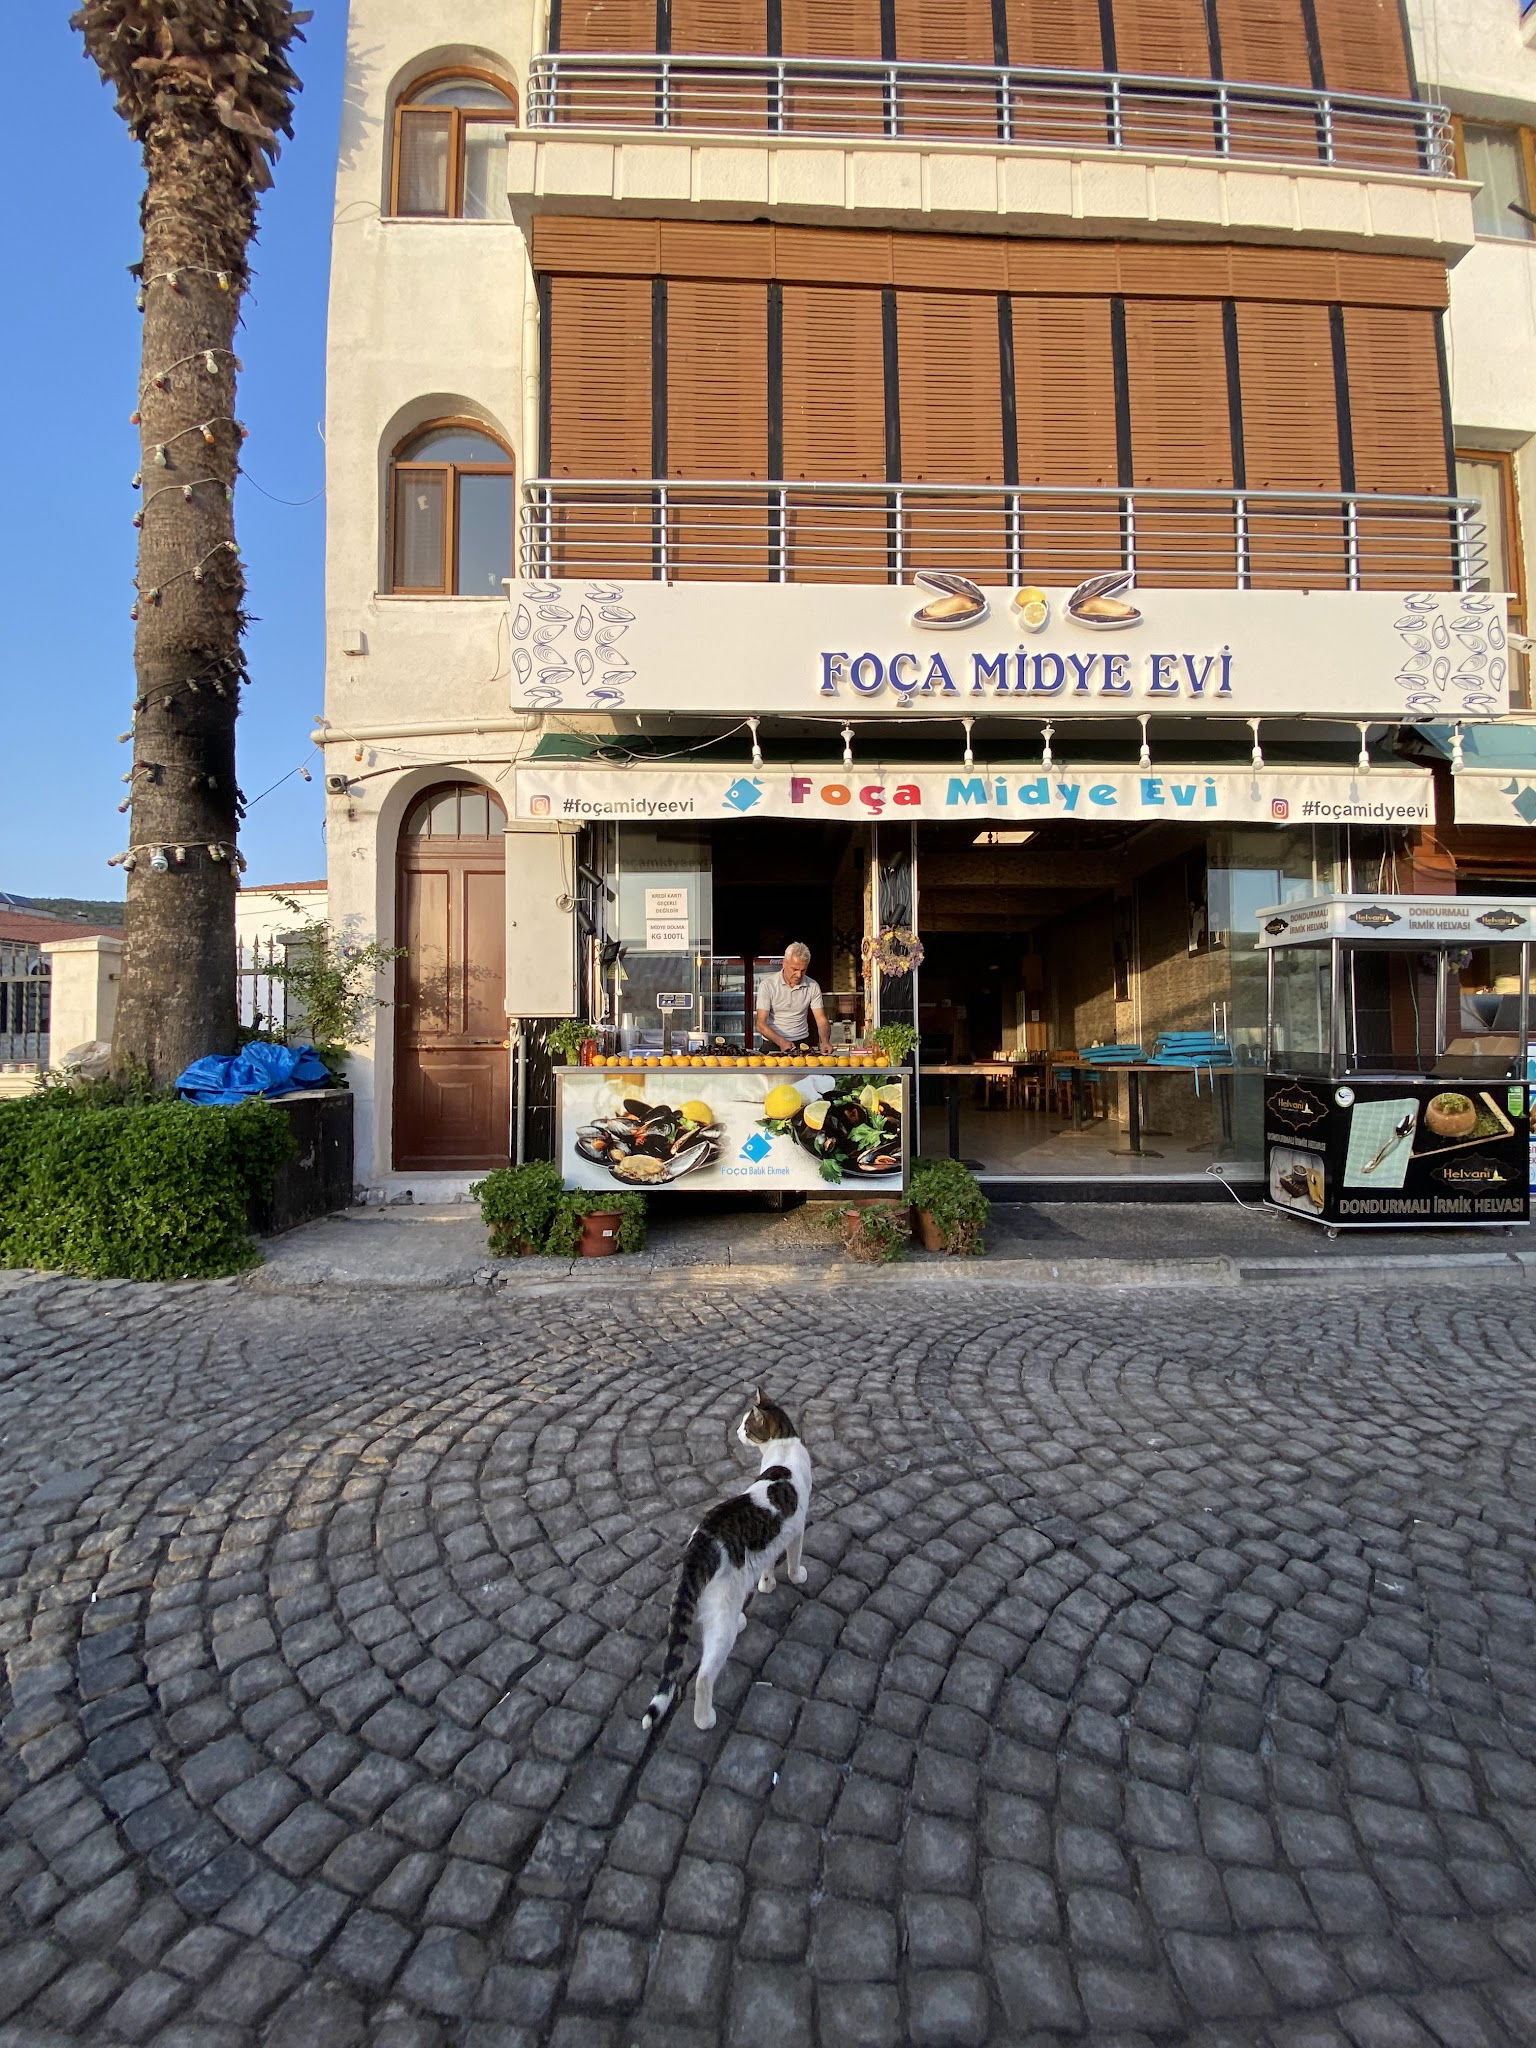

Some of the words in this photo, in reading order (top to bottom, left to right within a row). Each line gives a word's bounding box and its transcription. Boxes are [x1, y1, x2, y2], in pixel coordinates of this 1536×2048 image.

[820, 652, 957, 703] FOÇA
[971, 645, 1132, 693] MİDYE
[1149, 645, 1233, 693] EVİ
[791, 776, 922, 816] Foça
[945, 776, 1118, 811] Midye
[1140, 776, 1218, 808] Evi
[563, 797, 694, 818] #foçamidyeevi
[1302, 800, 1429, 821] #foçamidyeevi
[1290, 908, 1329, 922] DONDURMALI
[1409, 907, 1470, 917] DONDURMALI
[1306, 921, 1329, 933] HELVASI
[1409, 919, 1435, 930] İRMİK
[1436, 921, 1471, 930] HELVASI
[1278, 1098, 1304, 1110] Helvani
[721, 1166, 747, 1176] Foça
[748, 1166, 766, 1175] Balık
[767, 1166, 790, 1175] Ekmek
[1443, 1168, 1491, 1179] Helvani
[1339, 1199, 1431, 1214] DONDURMALI
[1433, 1195, 1472, 1214] İRMİK
[1474, 1197, 1524, 1213] HELVASI
